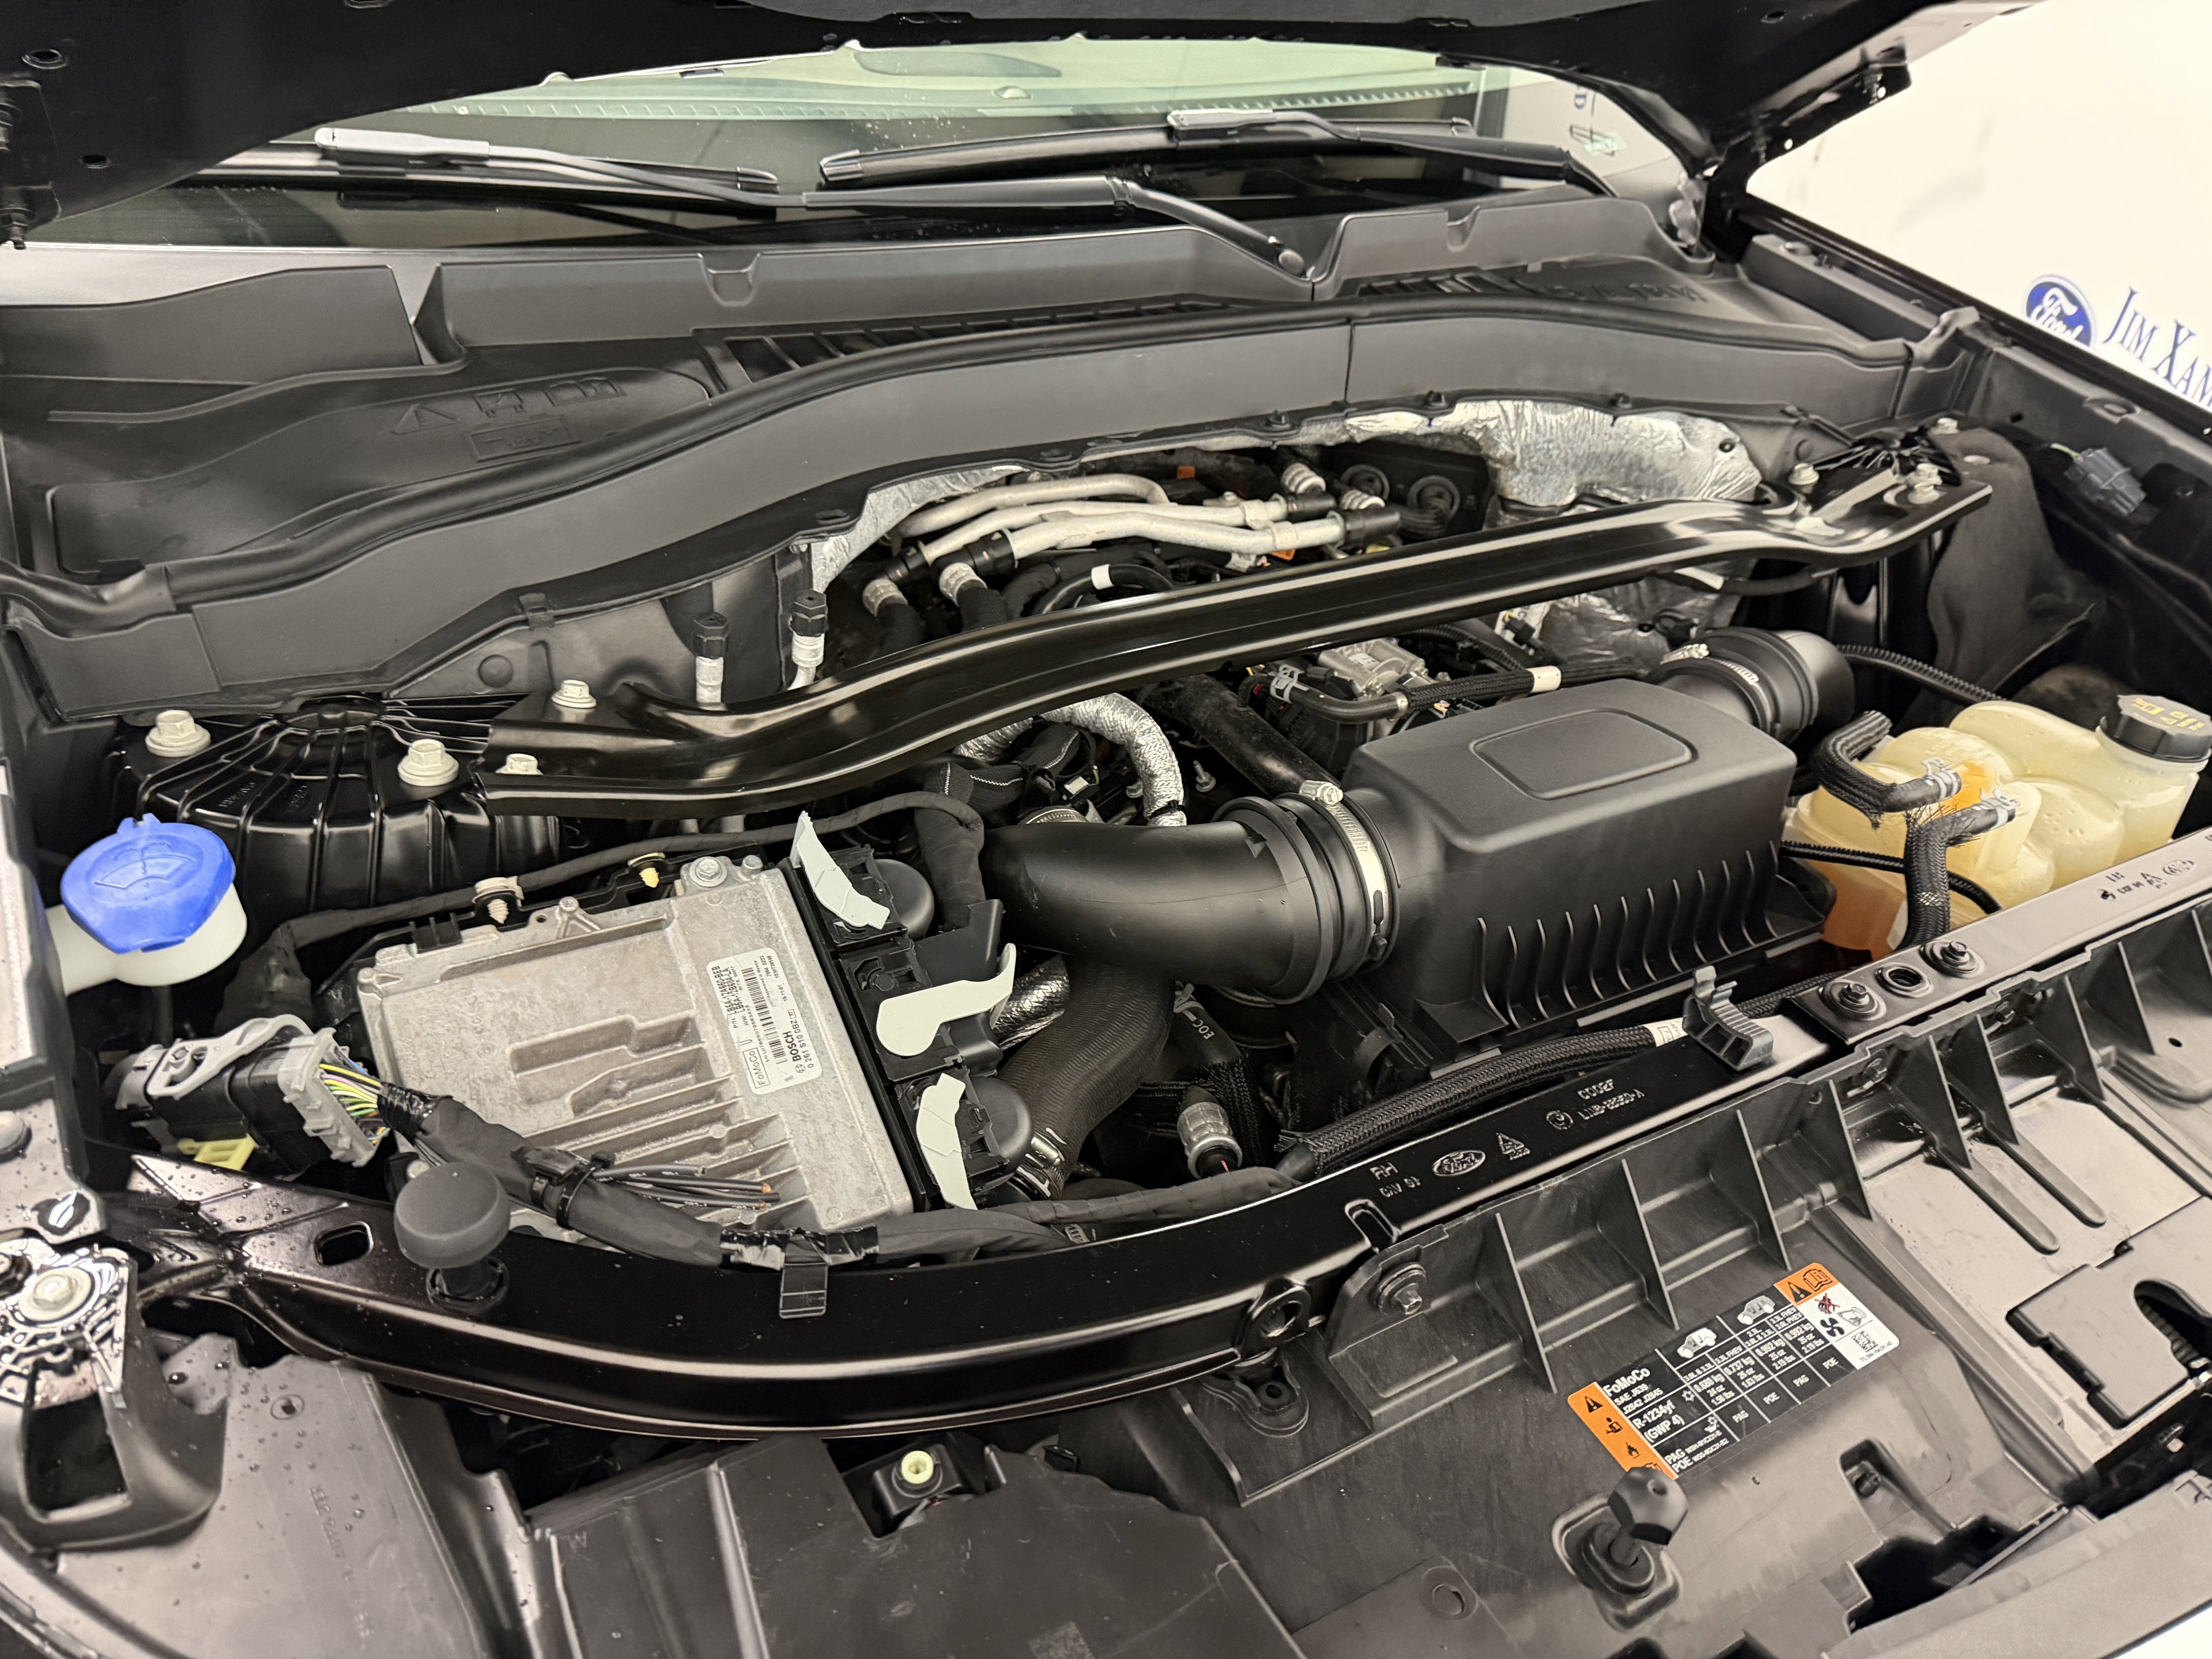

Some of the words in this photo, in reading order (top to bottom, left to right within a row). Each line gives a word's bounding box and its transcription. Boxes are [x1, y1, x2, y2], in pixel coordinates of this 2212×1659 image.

[2030, 287, 2084, 342] Ford
[2103, 286, 2160, 362] JIM
[1192, 1019, 1215, 1040] EOC
[783, 1031, 801, 1062] BOSCH
[796, 1035, 806, 1048] S10
[802, 1050, 812, 1062] 261
[749, 1051, 766, 1085] FoMoCo
[1370, 1163, 1398, 1180] RH
[1800, 1322, 1815, 1331] kg
[1772, 1338, 1786, 1347] kg
[1797, 1336, 1808, 1345] 35
[1812, 1338, 1824, 1347] lbs
[1740, 1356, 1755, 1365] kg
[1768, 1352, 1779, 1361] 35
[1783, 1355, 1796, 1363] lbs
[1822, 1357, 1838, 1369] POE
[1603, 1369, 1650, 1396] FoMoCo
[1711, 1373, 1725, 1382] kg
[1752, 1373, 1765, 1382] lbs
[1793, 1375, 1809, 1386] PAG
[1716, 1384, 1725, 1393] oz
[1614, 1392, 1632, 1405] SAE
[1722, 1391, 1735, 1399] lbs
[1763, 1392, 1779, 1404] POE
[1633, 1400, 1675, 1428] R-1234yf
[1732, 1410, 1749, 1423] PAG
[1644, 1420, 1671, 1443] (GWP
[1671, 1414, 1685, 1425] 4)
[1664, 1449, 1685, 1464] PAG
[1672, 1456, 1693, 1472] POE
